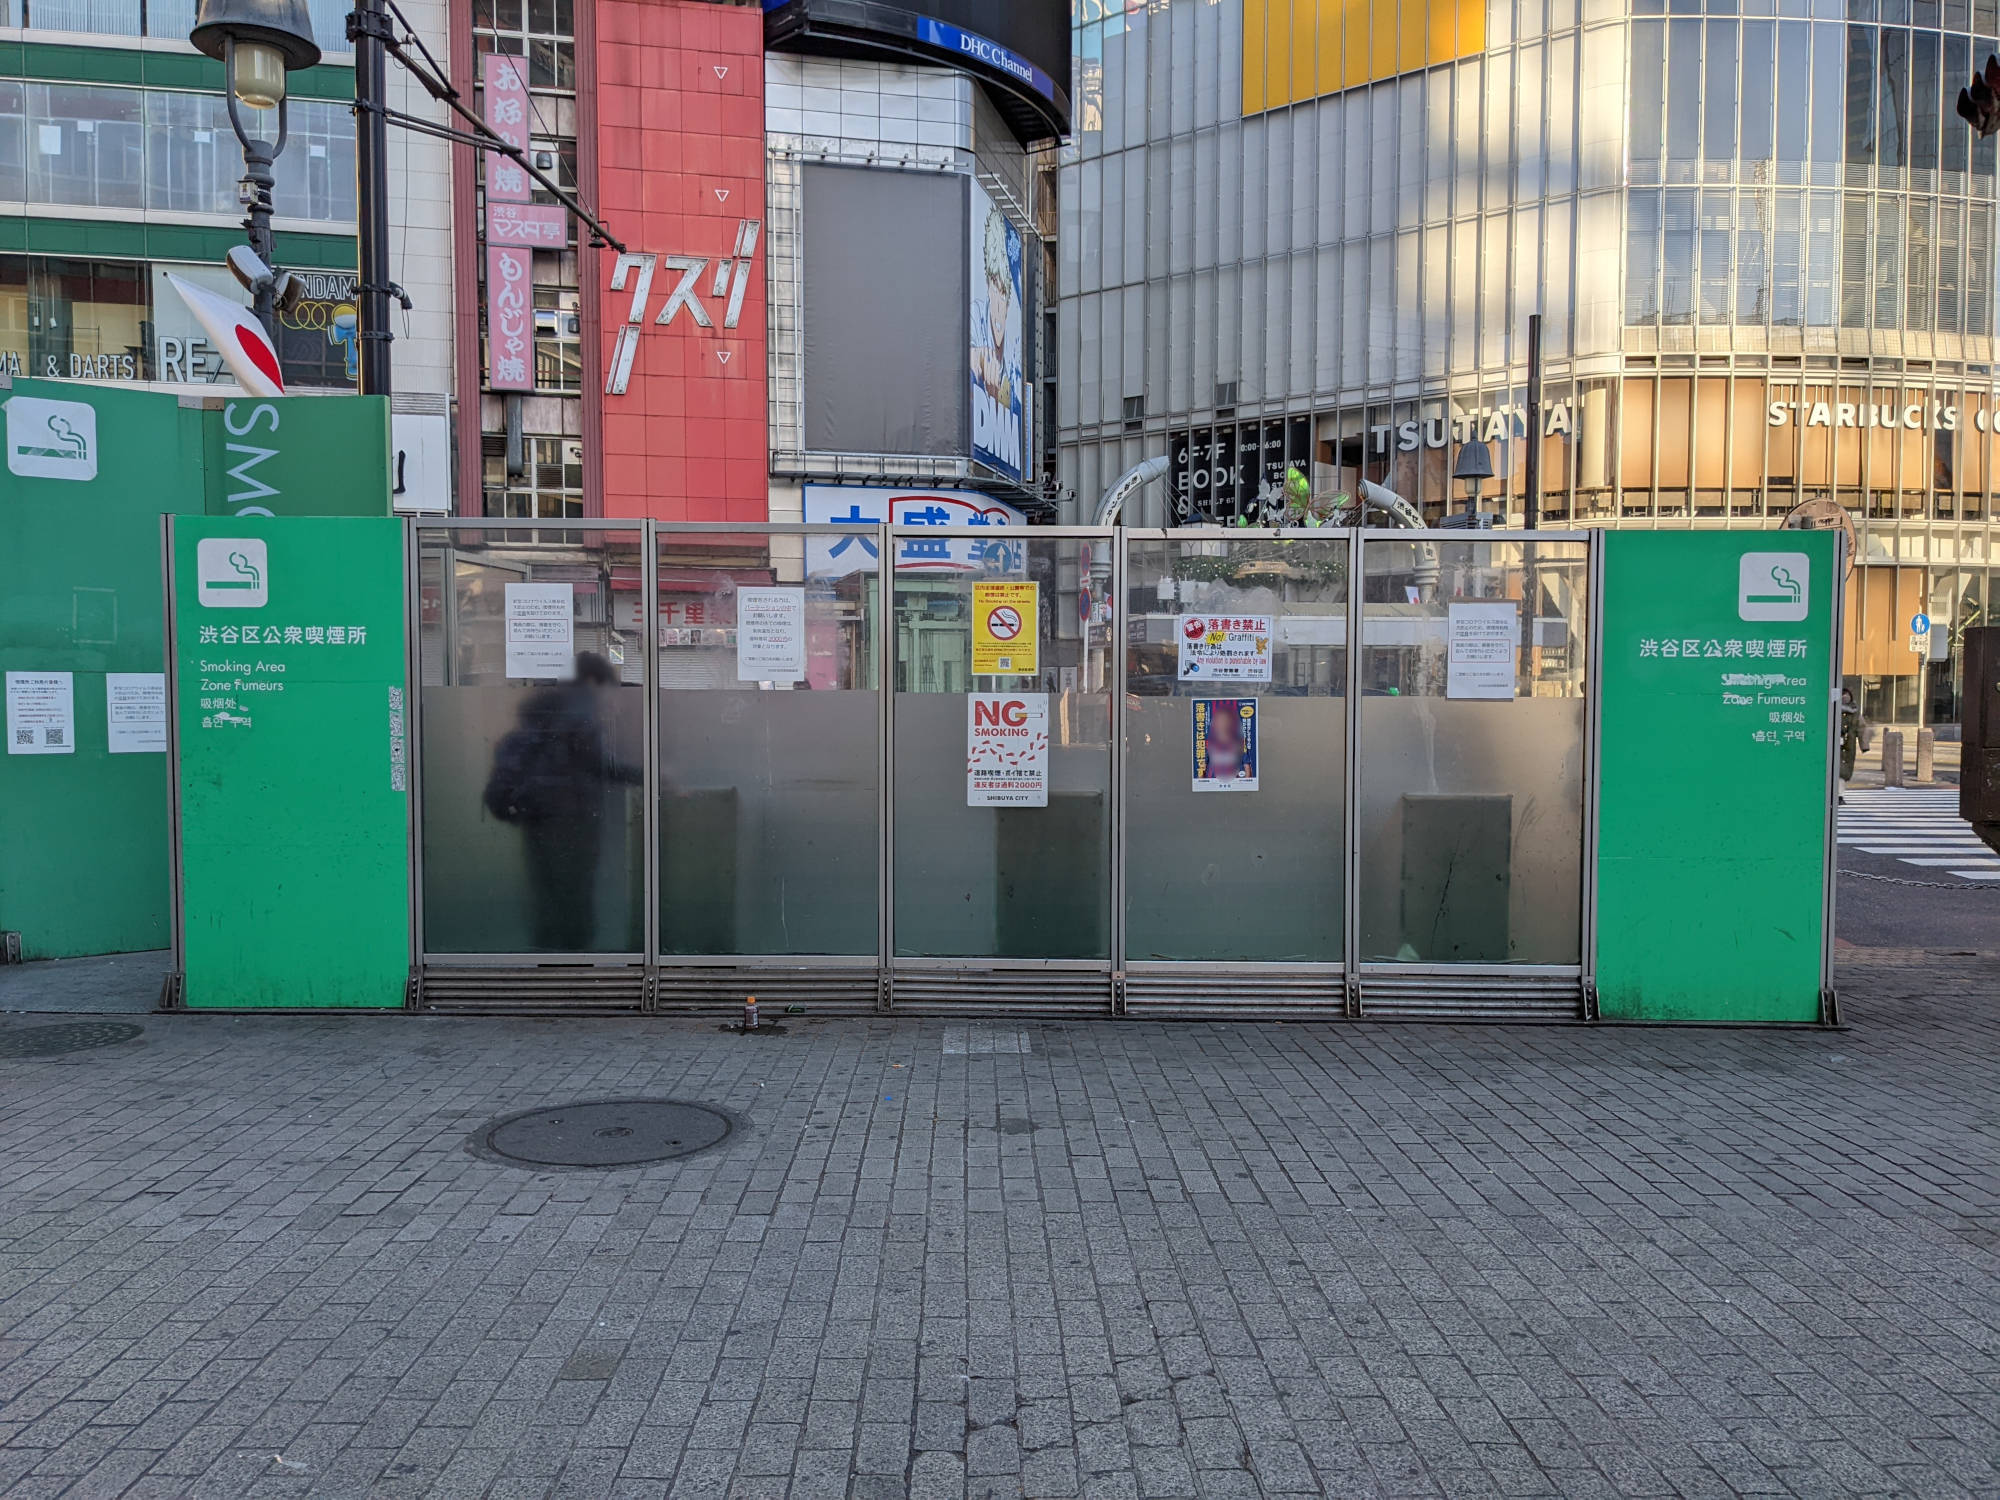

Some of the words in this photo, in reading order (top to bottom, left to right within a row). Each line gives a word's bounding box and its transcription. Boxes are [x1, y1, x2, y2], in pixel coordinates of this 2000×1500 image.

[960, 34, 990, 59] DHC
[991, 49, 1033, 83] Channel
[493, 206, 517, 218] 渋谷
[497, 252, 526, 383] もんじゃ焼
[47, 354, 60, 377] &
[70, 353, 134, 380] DARTS
[1768, 400, 1958, 431] STARBUCKS
[973, 382, 1021, 471] DMM
[1266, 459, 1307, 471] TSUAYA
[1207, 619, 1267, 631] 落書き禁止
[199, 625, 367, 645] 渋谷区公衆喫煙所
[1209, 633, 1225, 642] No!
[1228, 633, 1255, 642] Graffiti
[1639, 638, 1808, 659] 渋谷区公衆喫煙所
[200, 660, 251, 675] Smoking
[255, 660, 286, 673] Area
[200, 679, 231, 691] Zone
[234, 679, 284, 691] Fumeurs
[1721, 674, 1772, 689] Sing
[200, 698, 237, 709] 吸烟处
[1757, 693, 1806, 705] Fumeurs
[974, 700, 1028, 727] NG
[1768, 711, 1806, 724] 吸烟处
[974, 728, 1029, 737] SMOKING
[1783, 730, 1806, 742] 구역
